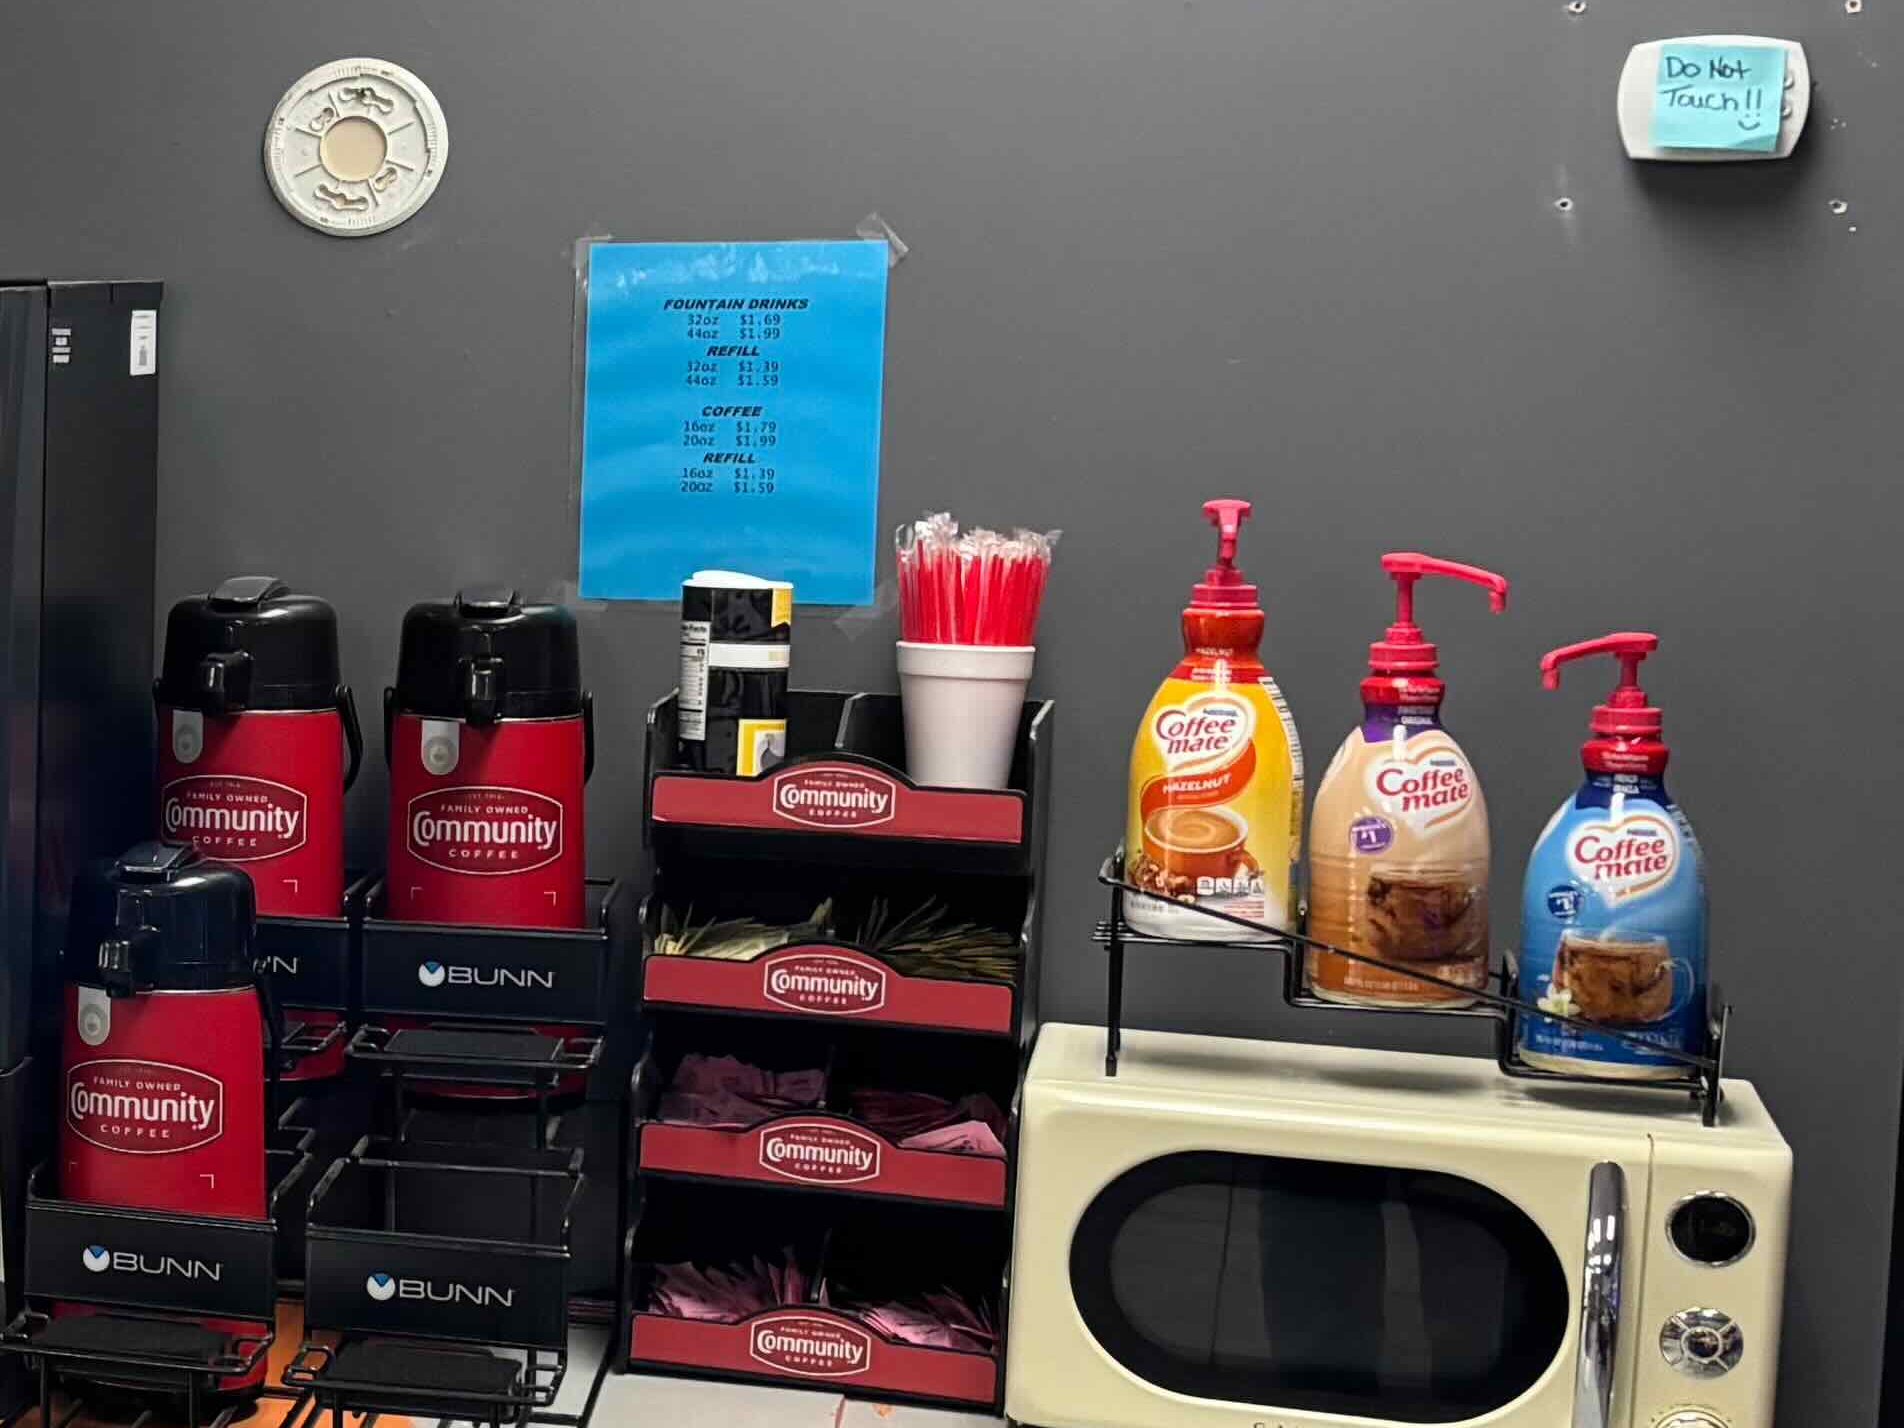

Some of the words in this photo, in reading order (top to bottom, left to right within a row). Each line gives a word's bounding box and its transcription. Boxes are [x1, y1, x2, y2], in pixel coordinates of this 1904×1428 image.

[1665, 56, 1701, 79] Do
[1709, 56, 1752, 80] Not
[664, 299, 744, 312] FOUNTAIN
[748, 298, 809, 311] DRINKS
[688, 314, 720, 326] 32oz
[740, 314, 782, 327] $1.69
[687, 328, 719, 340] 44oz
[739, 328, 782, 340] $1.99
[706, 345, 761, 357] REFILL
[687, 361, 718, 373] 32oz
[738, 360, 780, 373] $1.39
[686, 375, 717, 387] 44oz
[737, 374, 779, 387] $1.59
[701, 406, 763, 417] COFFEE
[683, 422, 716, 433] 16oz
[735, 421, 777, 434] $1.79
[682, 435, 715, 447] 20oz
[735, 435, 777, 447] $1.99
[702, 452, 756, 464] REFILL
[681, 468, 714, 479] 16oz
[734, 468, 775, 480] $1.39
[680, 481, 713, 493] 20oz
[733, 481, 775, 494] $1.59
[1156, 709, 1237, 741] Coffee
[1167, 735, 1229, 754] mate
[1163, 773, 1232, 794] HAZELNUT
[1376, 768, 1464, 797] Coffee
[187, 791, 221, 801] FAMILY
[226, 793, 268, 803] OWNED
[779, 783, 889, 815] Community
[1402, 783, 1469, 812] mate
[441, 804, 480, 813] FAMILY
[486, 805, 529, 815] OWNED
[809, 808, 857, 819] COFFEE
[166, 803, 299, 839] Community
[413, 812, 558, 850] Community
[192, 834, 257, 847] COFFEE
[448, 848, 519, 859] COFFEE
[1574, 836, 1665, 864] Coffee
[1595, 853, 1667, 880] mate
[448, 966, 555, 988] BUNN
[771, 969, 879, 1002] Community
[799, 994, 848, 1005] COFFEE
[94, 1075, 131, 1089] FAMILY
[135, 1081, 182, 1092] OWNED
[71, 1081, 215, 1131] Community
[100, 1123, 170, 1139] COFFEE
[766, 1136, 874, 1171] Community
[794, 1163, 843, 1174] COFFEE
[113, 1251, 221, 1282] BUNN
[399, 1278, 514, 1308] BUNN
[757, 1329, 864, 1365] Community
[785, 1355, 833, 1367] COFFEE
